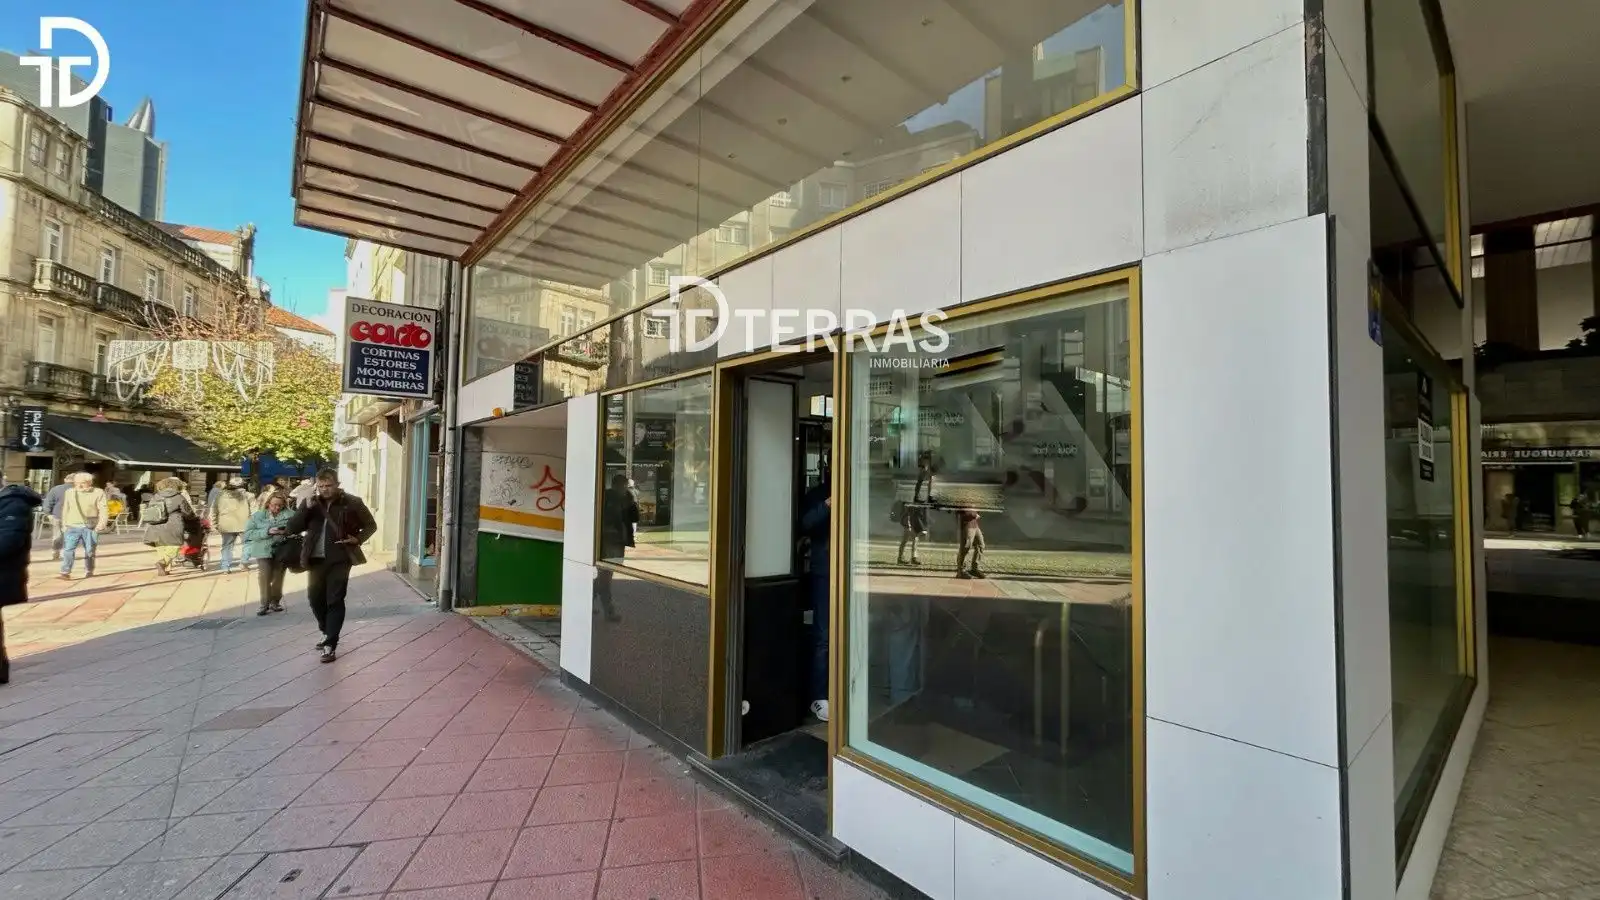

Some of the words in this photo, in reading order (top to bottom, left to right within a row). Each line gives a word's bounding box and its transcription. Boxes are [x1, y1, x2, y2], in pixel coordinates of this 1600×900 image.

[352, 303, 431, 323] DECORACIÓN
[361, 347, 420, 361] CORTINAS
[364, 357, 417, 370] ESTORES
[356, 367, 423, 381] MOQUETAS
[353, 377, 425, 390] ALFOMBRAS
[22, 410, 42, 446] Central
